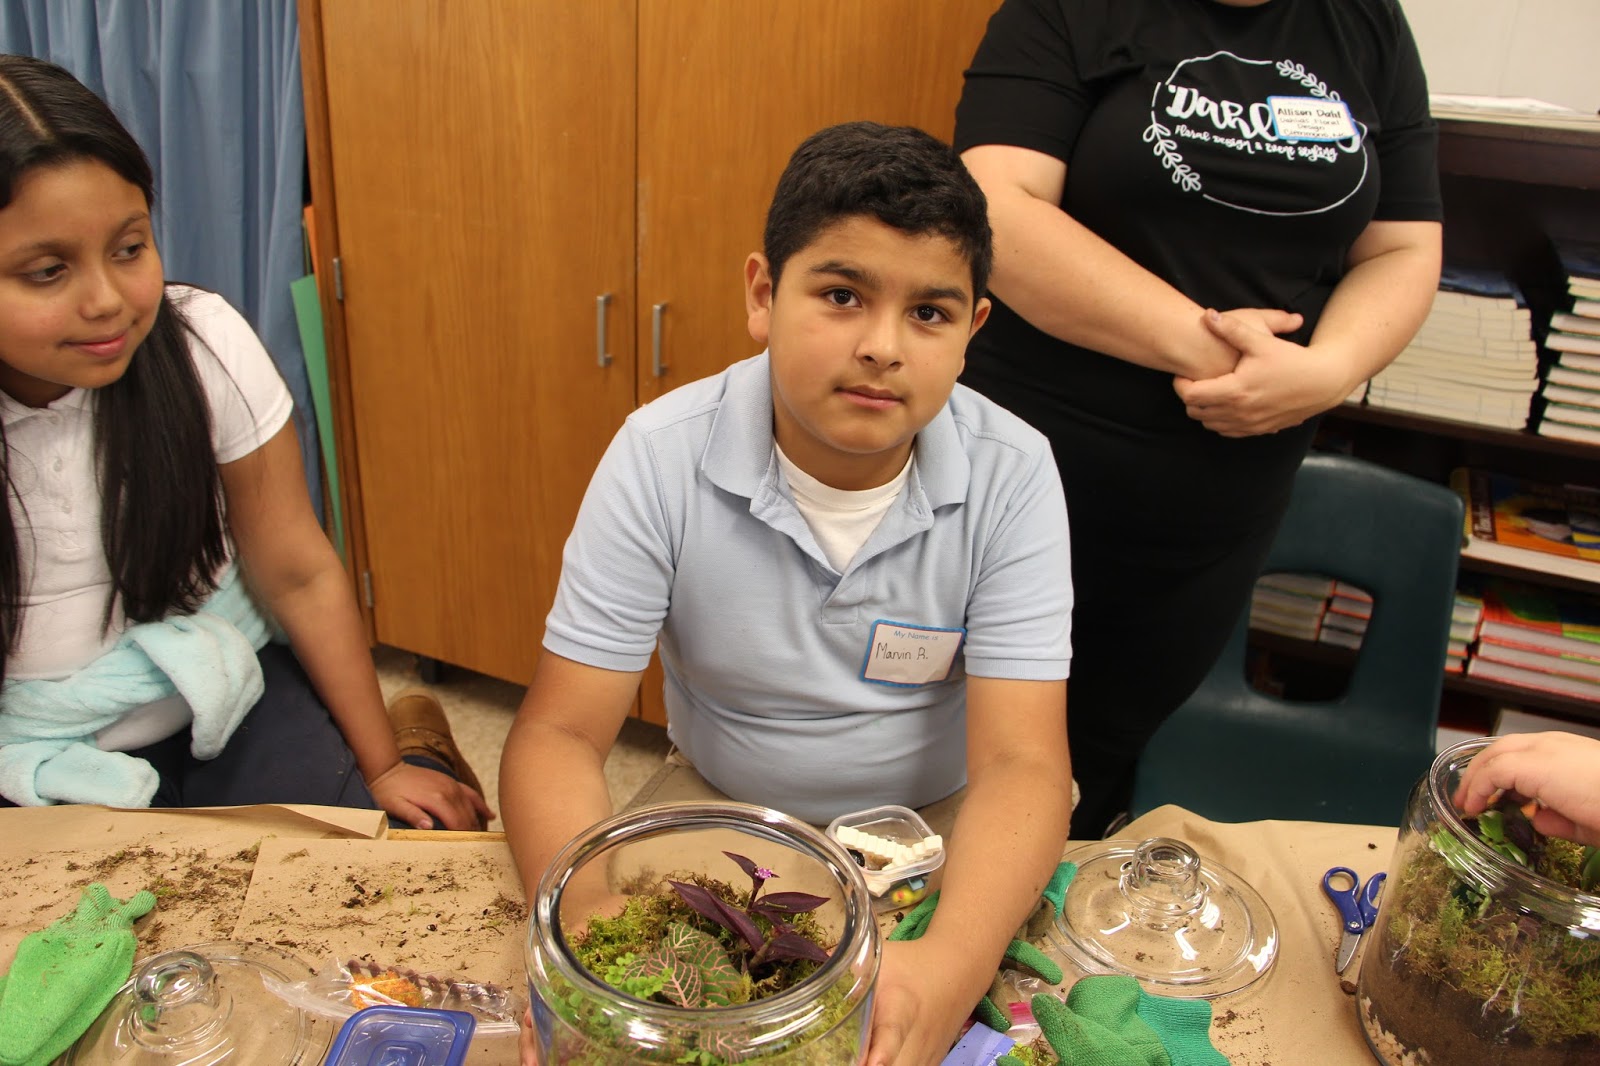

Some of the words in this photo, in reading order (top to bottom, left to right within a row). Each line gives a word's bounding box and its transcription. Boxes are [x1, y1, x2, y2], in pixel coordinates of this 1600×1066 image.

[1277, 107, 1312, 116] Allison
[1316, 109, 1341, 118] Dahl
[1174, 124, 1210, 142] Floral
[893, 630, 906, 639] My
[907, 632, 930, 640] Name
[875, 642, 912, 660] Marvin
